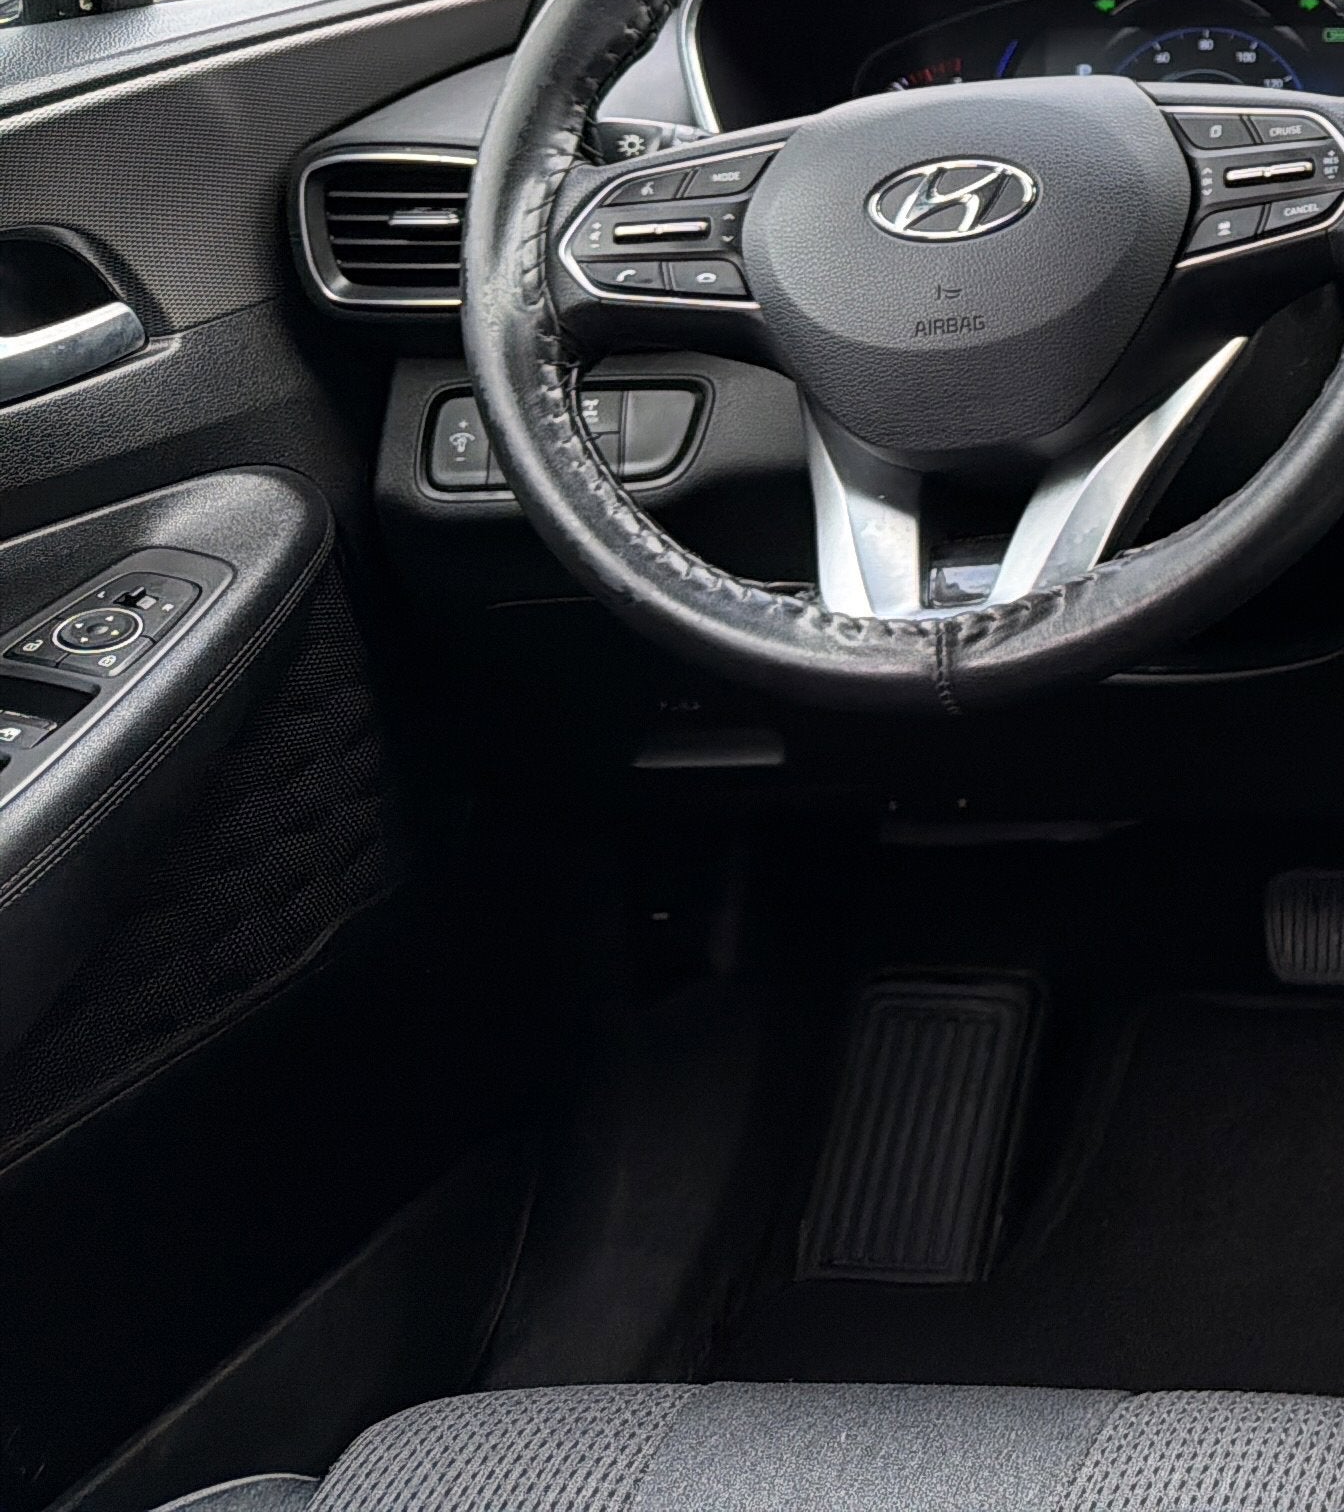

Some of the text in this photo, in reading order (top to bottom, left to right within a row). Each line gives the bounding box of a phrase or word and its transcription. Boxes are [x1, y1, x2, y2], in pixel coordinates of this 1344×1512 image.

[1198, 40, 1214, 51] 80
[1236, 51, 1257, 64] 100
[1269, 125, 1303, 137] CRUISE
[1322, 156, 1340, 165] RES
[1323, 165, 1339, 175] SET
[712, 171, 741, 182] MODE
[1283, 203, 1320, 217] CANCEL
[914, 315, 986, 337] AIRBAG
